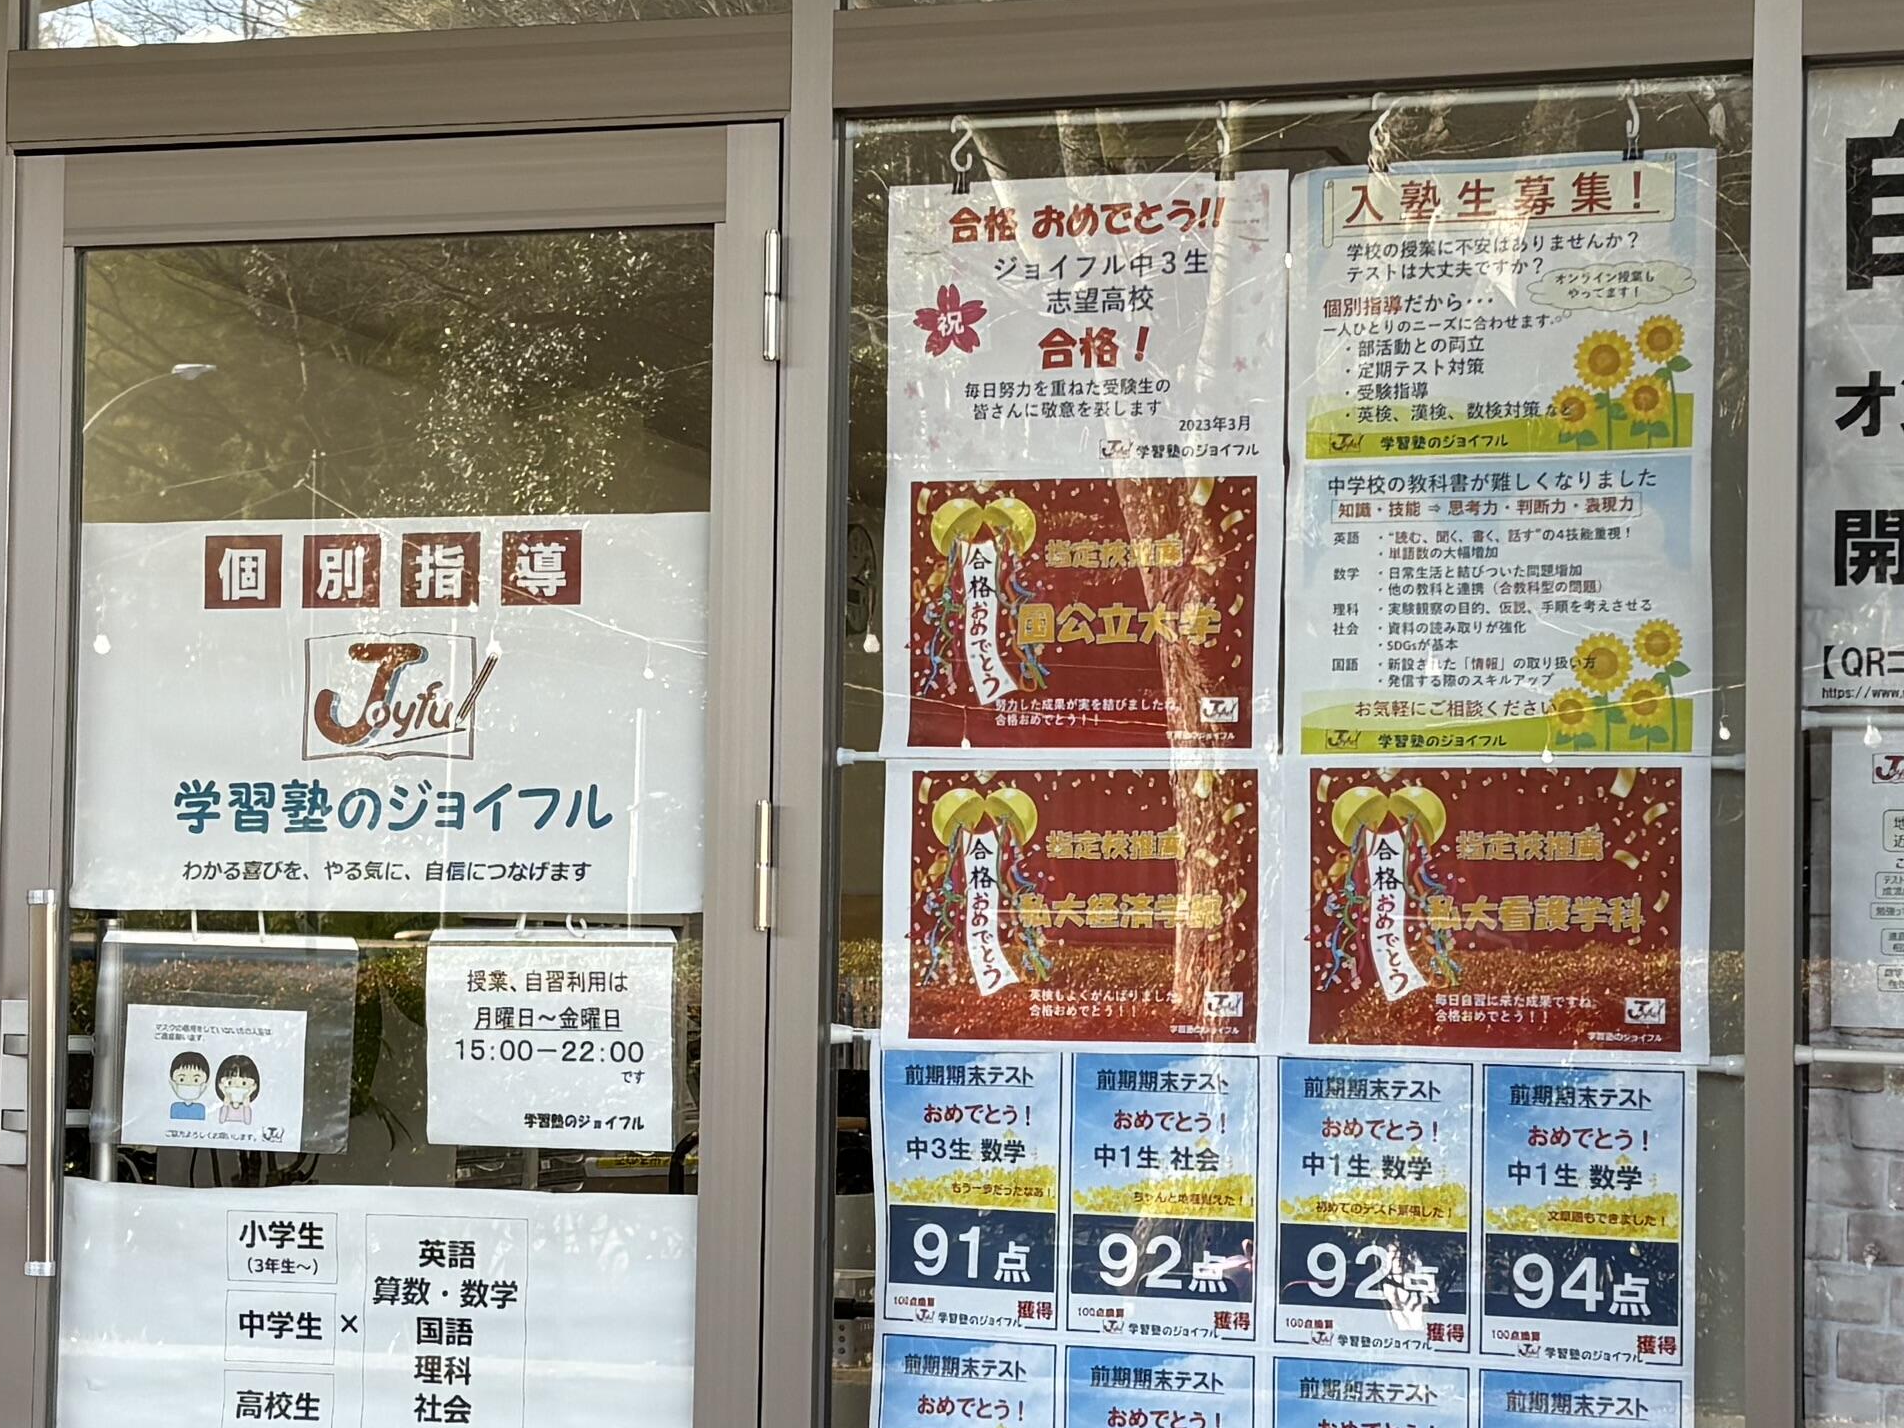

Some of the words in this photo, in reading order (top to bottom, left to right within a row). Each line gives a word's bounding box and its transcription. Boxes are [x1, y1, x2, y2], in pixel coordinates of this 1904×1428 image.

[1345, 171, 1641, 225] 入塾生募集！
[949, 206, 1017, 244] 合格
[1032, 197, 1225, 239] おめでとう!!
[1347, 231, 1639, 261] 学校の授業に不安はありませんか？
[994, 250, 1209, 281] ジョイフル中３生
[1347, 258, 1542, 283] テストは大丈夫ですか？
[1046, 285, 1154, 314] 志望高校
[936, 311, 965, 336] 祝
[1323, 314, 1554, 336] 一人ひとりのニーズに合わせます。
[1039, 326, 1150, 370] 合格！
[1358, 338, 1485, 357] 部活動との両立
[1358, 358, 1485, 379] 定期テスト対策
[964, 379, 1170, 400] 毎日努力を重ねた受験生の
[1356, 382, 1428, 401] 受験指導
[974, 399, 1162, 421] 皆さんに敬意を表します
[1357, 402, 1541, 424] 英検、漢検、数検対策
[1178, 416, 1251, 432] 2023年3月
[1136, 443, 1259, 459] 学習塾のジョイフル
[1381, 432, 1508, 449] 学習塾のジョイフル
[1328, 468, 1657, 493] 中学校の教科書が難しくなりました
[1338, 502, 1420, 518] 知識・技能
[1334, 532, 1360, 546] 英語
[1388, 546, 1499, 560] 単語数の大幅増加
[218, 543, 568, 601] 個別指導
[1334, 567, 1359, 581] 数学
[1388, 564, 1583, 579] 日常生活と結びついた問題増加
[968, 548, 1001, 698] 合格おめでとう
[1333, 604, 1359, 618] 理科
[1018, 602, 1221, 646] 国公立大学
[1333, 622, 1358, 637] 社会
[1388, 620, 1527, 636] 資料の読み取りが強化
[1387, 638, 1458, 652] SDGsが基本
[1332, 658, 1359, 672] 国語
[1388, 673, 1553, 687] 発信する際のスキルアップ
[1355, 700, 1557, 718] お気軽にご相談ください
[1378, 734, 1507, 748] 学習塾のジョイフル
[175, 778, 613, 835] 学習塾のジョイフル
[182, 860, 592, 884] わかる喜びを、やる気に、自信につなげます
[969, 838, 1003, 990] 合格おめでとう
[1372, 838, 1410, 994] 合格おめでとう
[1428, 894, 1645, 932] 私大看護学科
[467, 970, 628, 993] 授業、自習利用は
[474, 1006, 621, 1030] 月曜日～金曜日
[621, 1071, 645, 1084] です
[524, 1113, 644, 1130] 学習塾のジョイフル
[239, 1220, 325, 1250] 小学生
[419, 1239, 476, 1269] 英語
[913, 1223, 1031, 1283] 91点
[1098, 1233, 1228, 1293] 92点
[1306, 1243, 1440, 1304] 92点
[1512, 1253, 1651, 1317] 94点
[373, 1276, 518, 1309] 算数・数学
[239, 1310, 323, 1341] 中学生
[416, 1317, 474, 1347] 国語
[414, 1355, 472, 1386] 理科
[234, 1389, 321, 1422] 高校生
[413, 1394, 472, 1424] 社会
